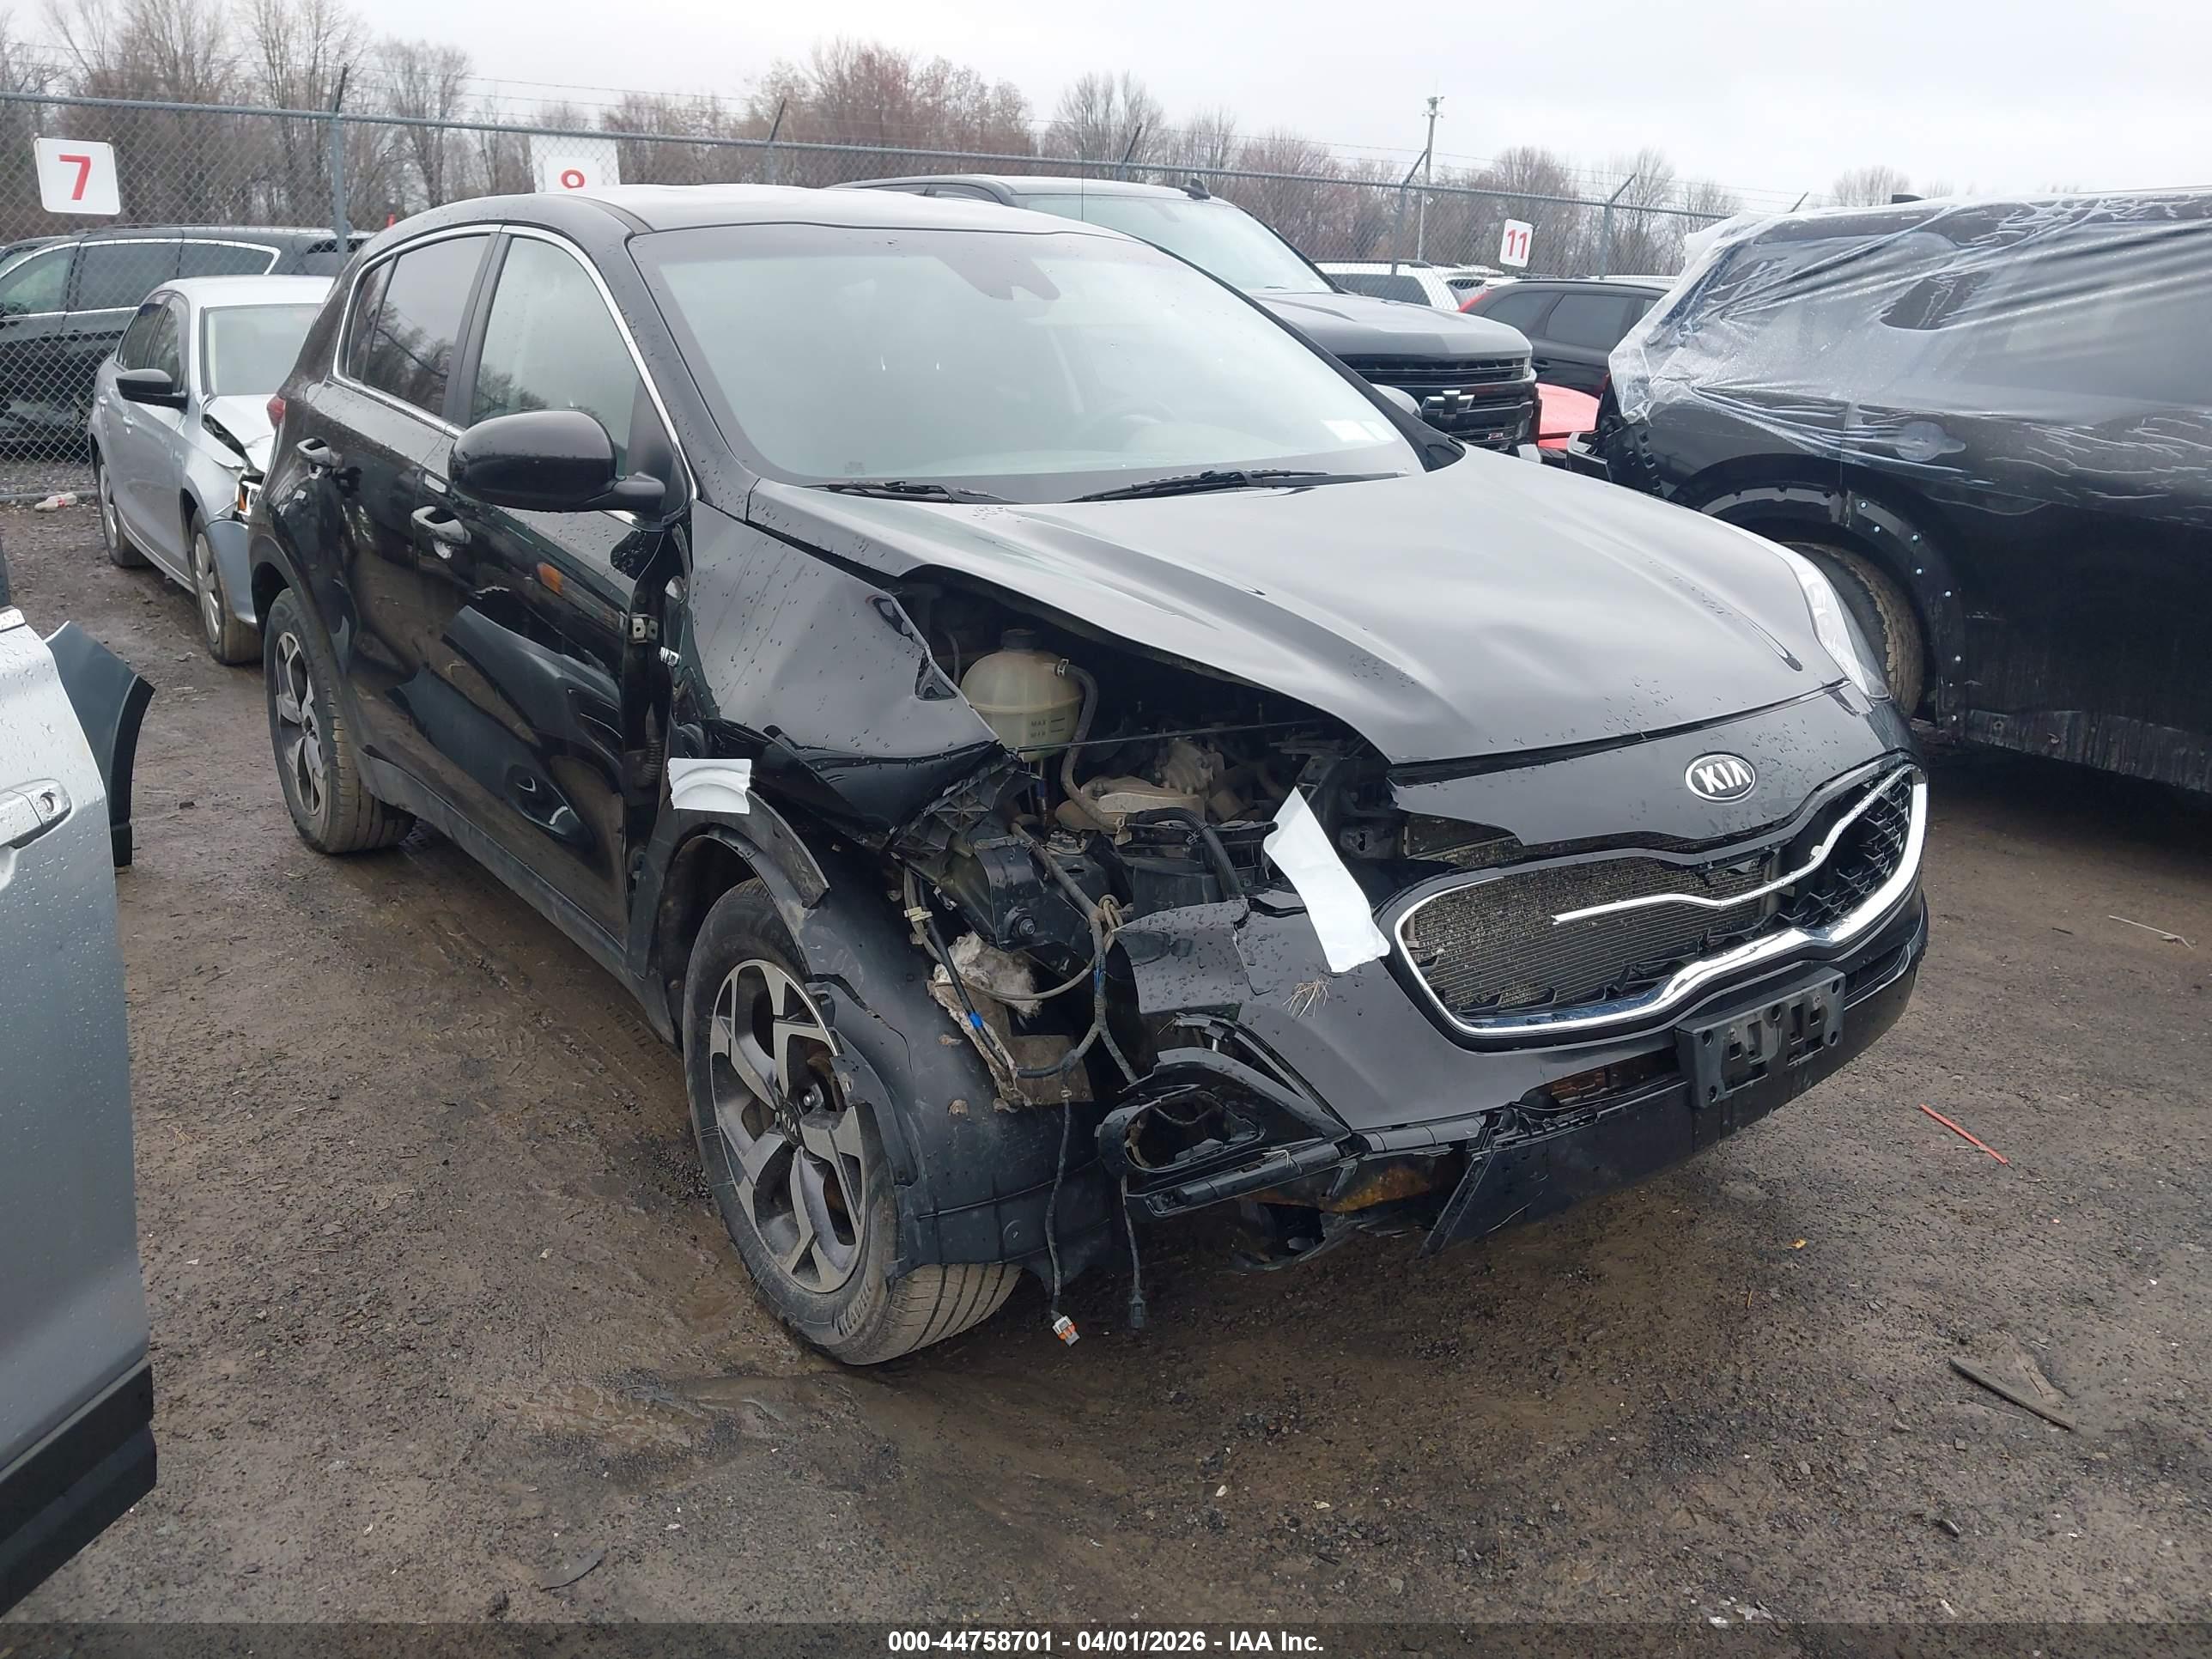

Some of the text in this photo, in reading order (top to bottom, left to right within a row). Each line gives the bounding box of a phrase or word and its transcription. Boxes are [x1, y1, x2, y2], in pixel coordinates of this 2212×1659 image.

[58, 155, 91, 200] 7
[1508, 229, 1528, 258] 11
[1694, 760, 1753, 793] KIA
[781, 1109, 798, 1138] KIA
